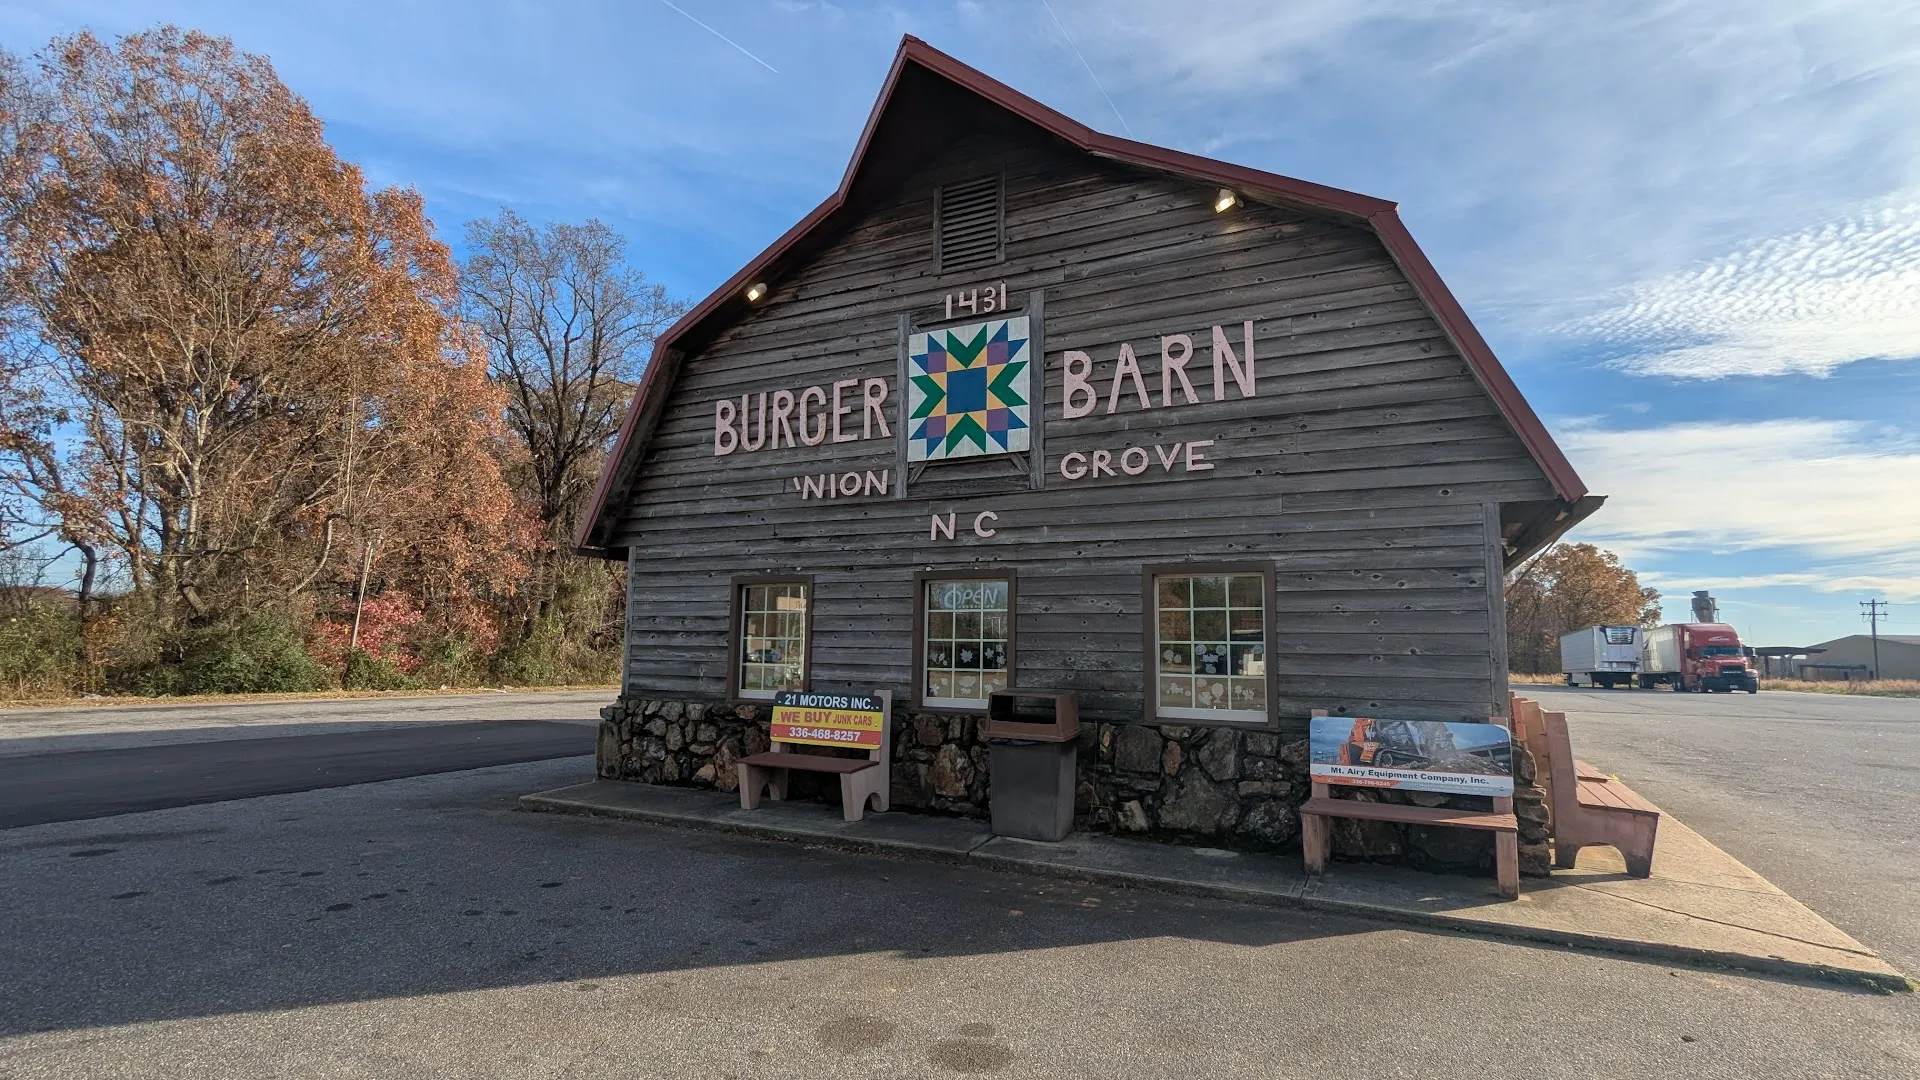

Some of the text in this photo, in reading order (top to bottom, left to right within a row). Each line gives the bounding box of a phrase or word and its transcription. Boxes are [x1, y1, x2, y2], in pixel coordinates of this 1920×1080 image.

[945, 283, 1007, 320] 1431
[714, 320, 1256, 456] BURGER BARN
[793, 439, 1215, 500] NION GROVE
[930, 510, 999, 541] N C
[944, 588, 998, 608] OPEN
[784, 694, 875, 710] 21 MOTORS INC.
[780, 711, 873, 727] WE BUY JUNK CARS
[788, 726, 861, 742] 336-468-8257
[1330, 766, 1490, 785] Mt. Airy Equipment Company, Inc.
